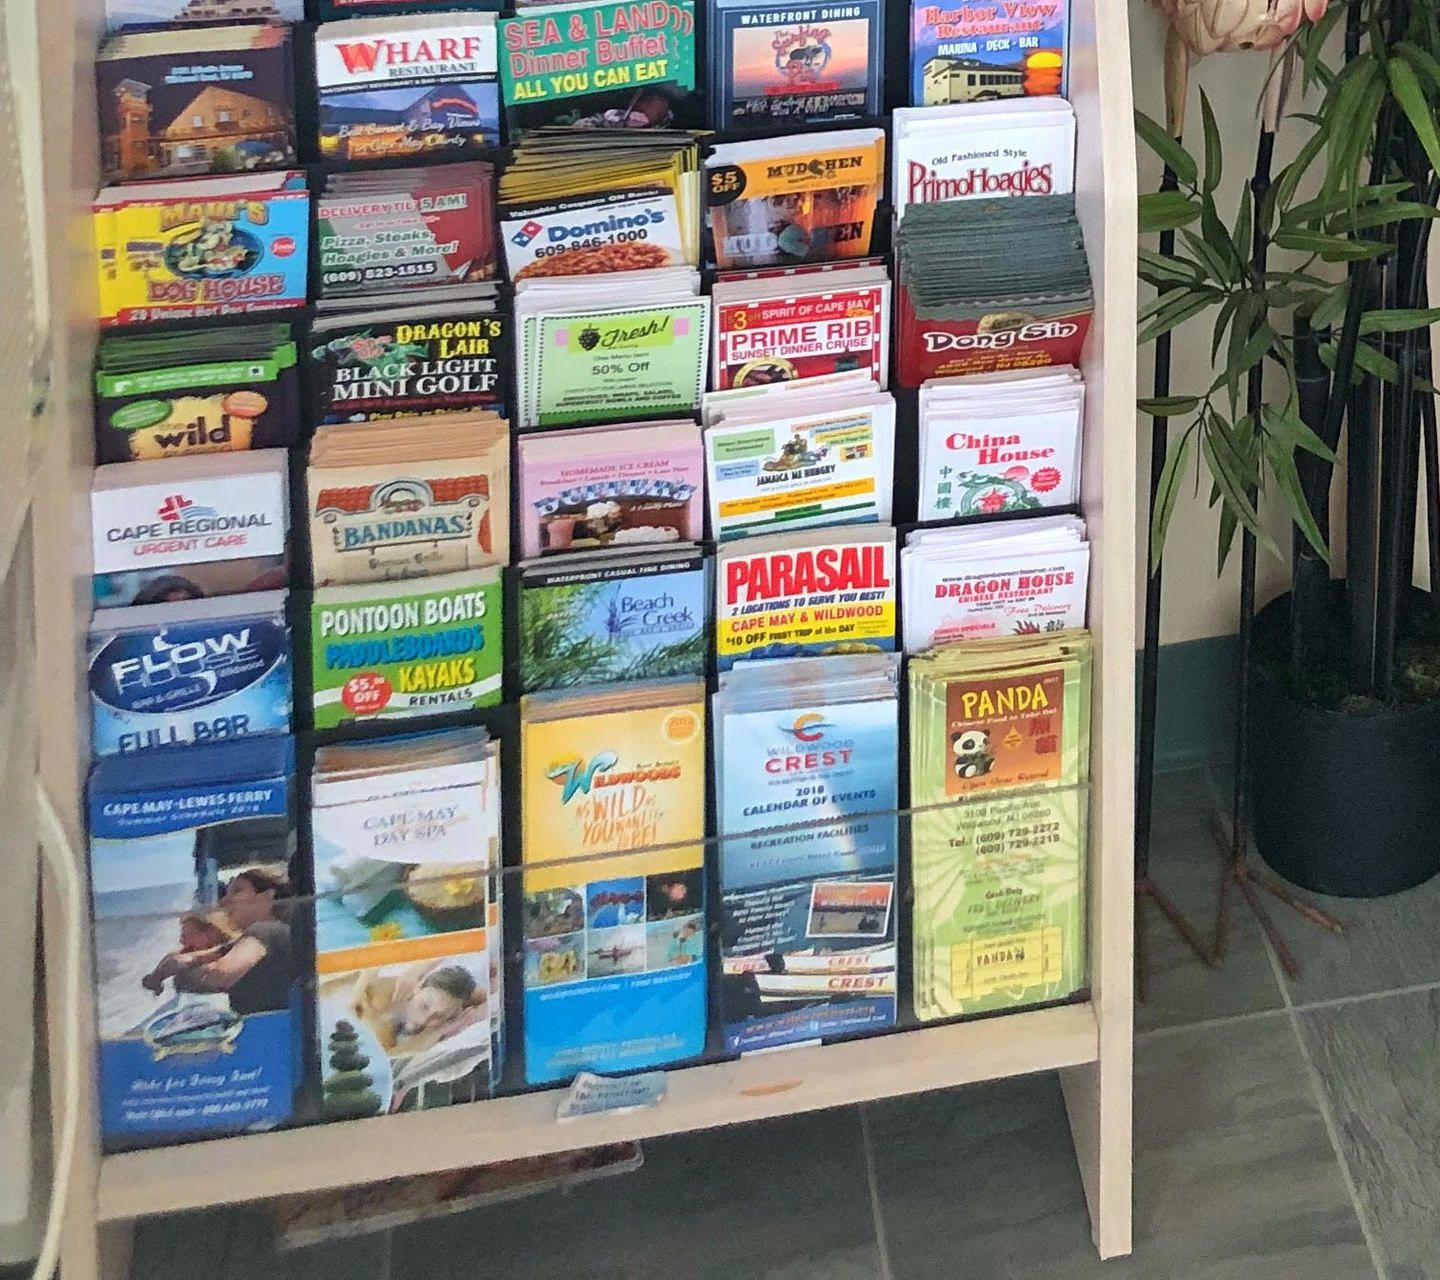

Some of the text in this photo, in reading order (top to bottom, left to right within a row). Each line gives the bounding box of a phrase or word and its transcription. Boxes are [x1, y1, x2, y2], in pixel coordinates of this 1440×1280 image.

[741, 6, 861, 25] WATERFRONT DINING
[336, 37, 481, 75] WHARF
[389, 61, 478, 77] RESTAURANT
[513, 59, 668, 101] ALL YOU CAN EAT
[547, 208, 667, 242] Domino's
[535, 228, 649, 259] 609-846-1000
[323, 262, 435, 284] (609) 523-1515
[731, 318, 872, 351] PRIME RIB
[923, 322, 1078, 353] Dong Sin
[335, 358, 497, 384] BLACK LIGHT
[591, 360, 650, 376] 50% Off
[332, 373, 499, 402] MINI GOLF
[945, 430, 1021, 451] China
[978, 445, 1056, 466] House
[107, 513, 272, 543] CAPE REGIONAL
[343, 515, 466, 547] BANDANAS
[726, 546, 890, 605] PARASAIL
[934, 572, 1075, 599] DRAGON HOUSE
[321, 592, 486, 636] PONTOON BOATS
[621, 591, 674, 611] Beach
[731, 605, 883, 633] CAPE MAY & WILDWOOD
[399, 658, 475, 693] KAYAKS
[961, 683, 1049, 720] PANDA
[764, 749, 854, 774] CREST
[743, 789, 876, 817] CALENDAR OF EVENTS
[827, 976, 888, 990] CREST
